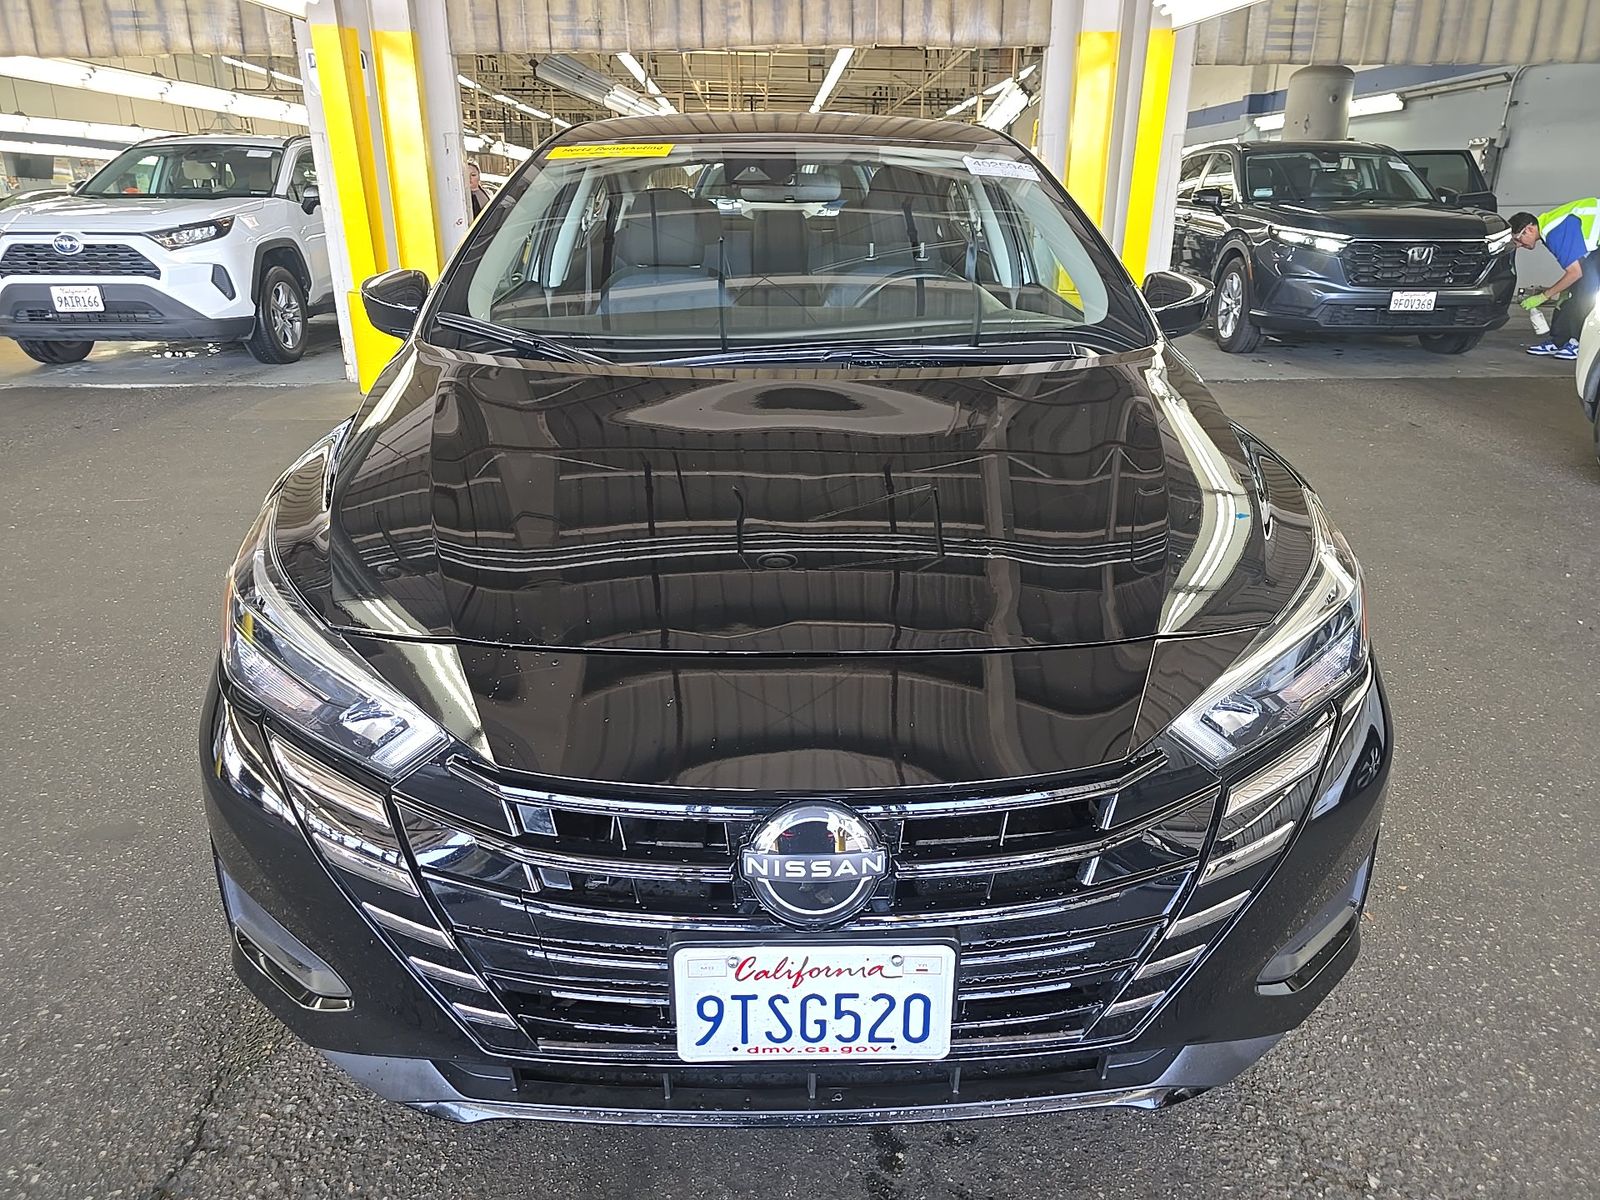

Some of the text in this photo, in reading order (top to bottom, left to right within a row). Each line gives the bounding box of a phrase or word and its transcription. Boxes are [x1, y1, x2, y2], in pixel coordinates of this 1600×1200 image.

[57, 295, 99, 307] 9AIR166
[746, 855, 883, 879] NISSAN
[734, 956, 903, 989] California
[694, 992, 932, 1047] 9TSG520
[746, 1045, 883, 1055] dmv.ca.gov
